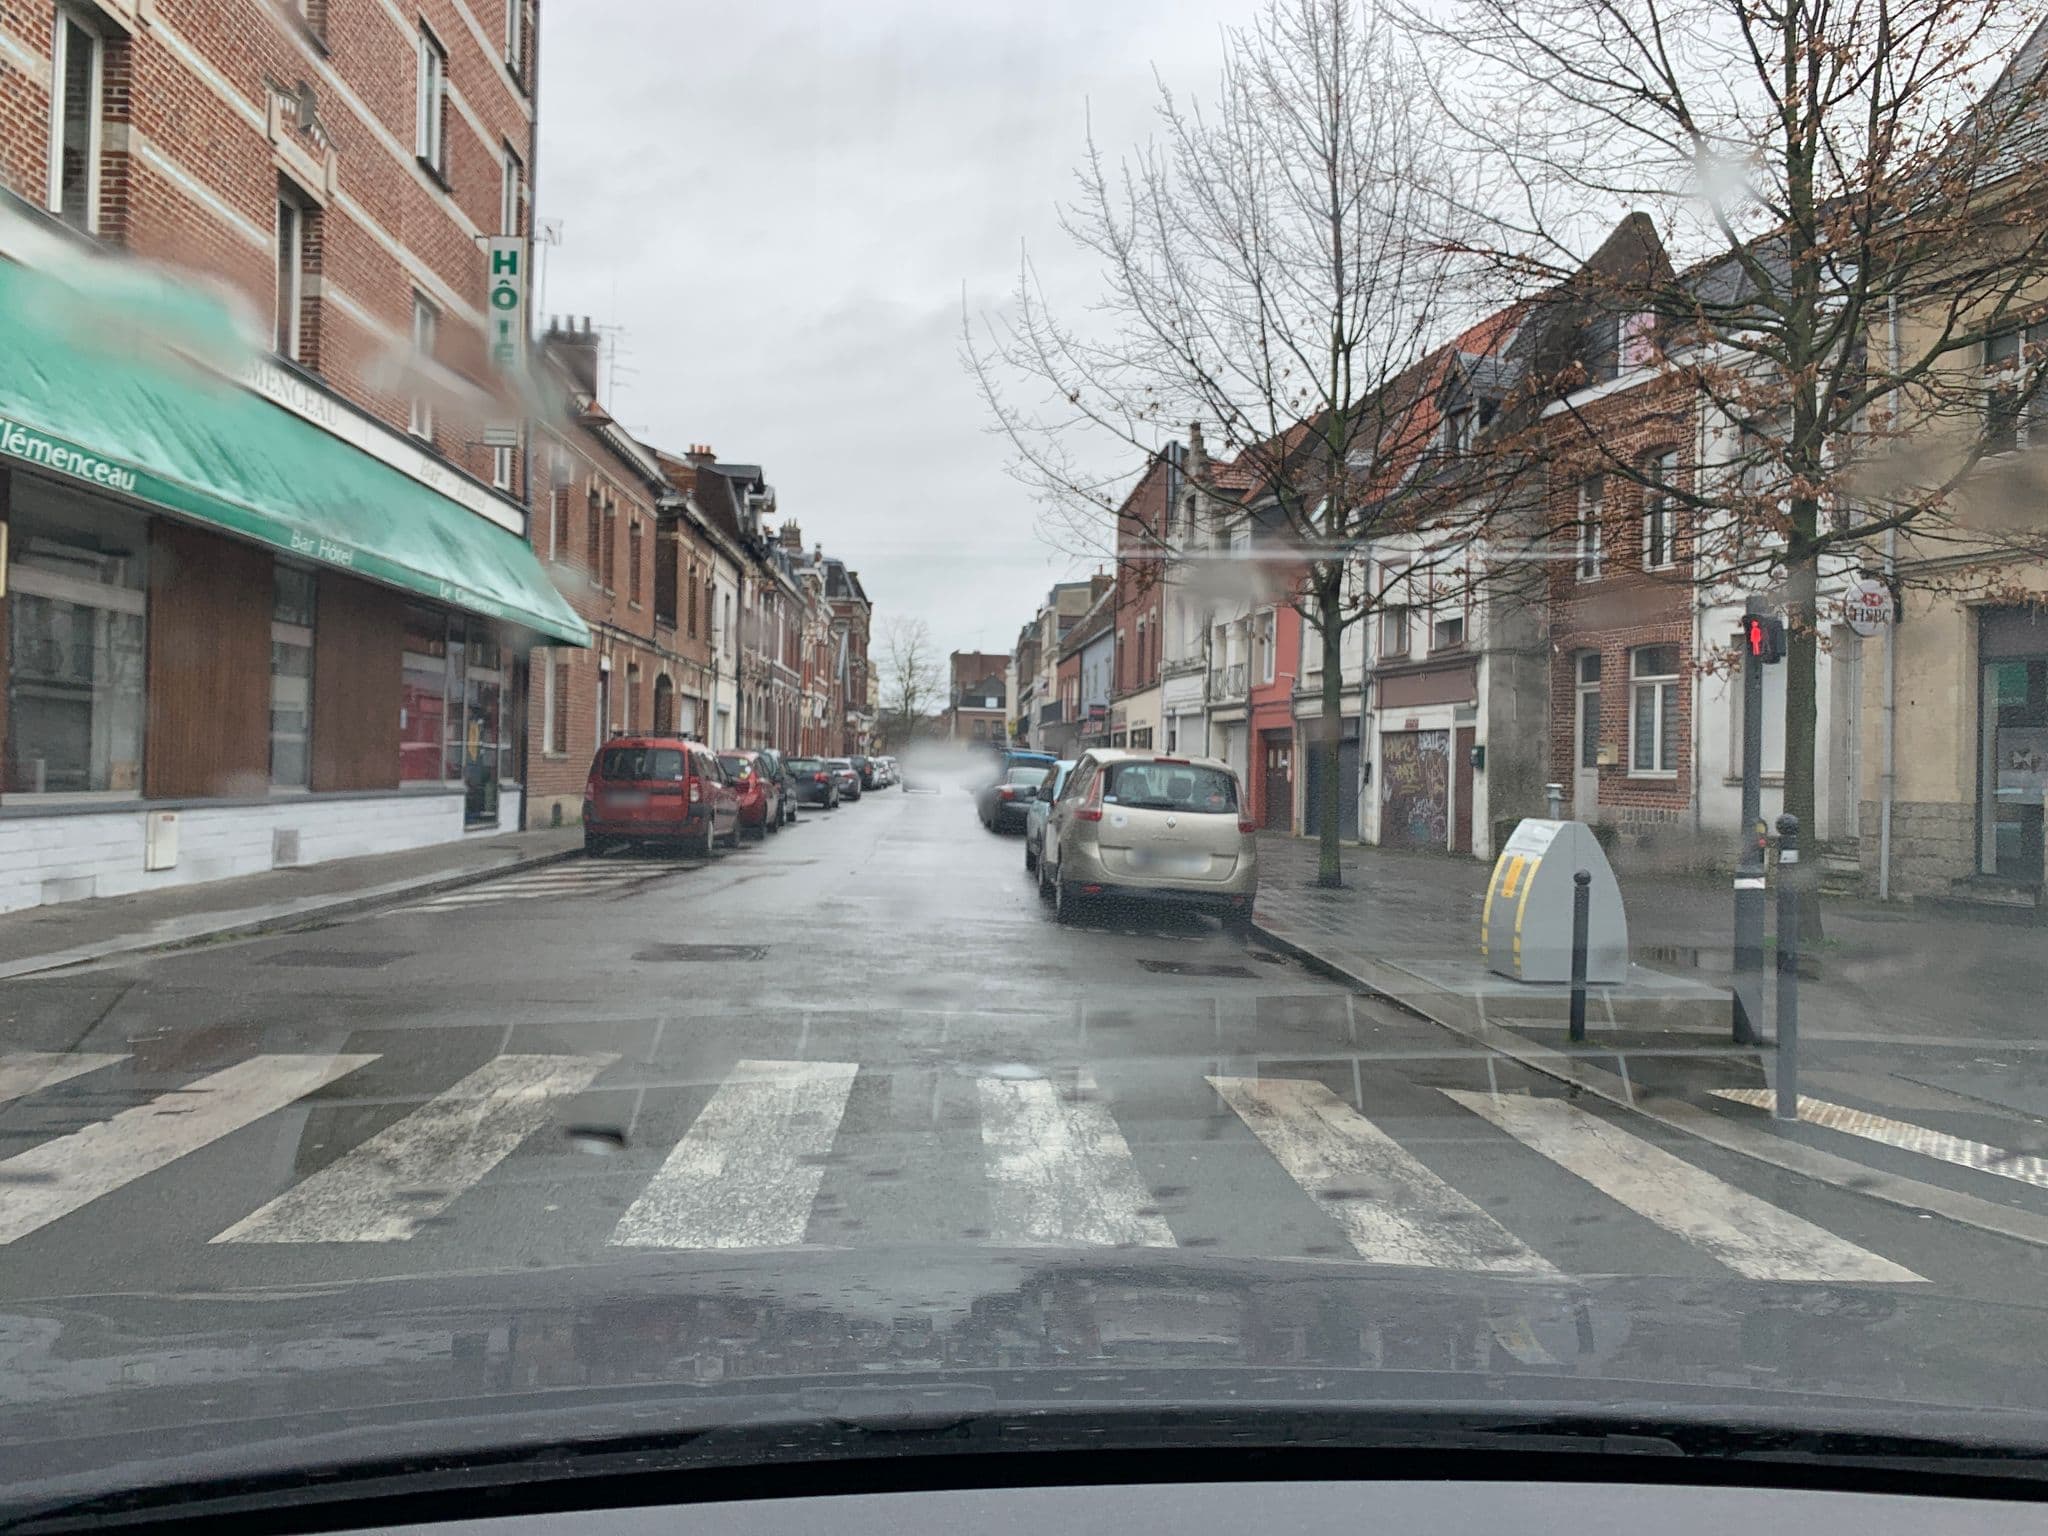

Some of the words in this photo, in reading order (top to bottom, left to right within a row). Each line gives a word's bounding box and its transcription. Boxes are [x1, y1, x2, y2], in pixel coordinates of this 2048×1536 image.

[0, 419, 137, 491] lémenceau
[290, 528, 316, 553] Bar
[319, 536, 353, 567] Hôtel
